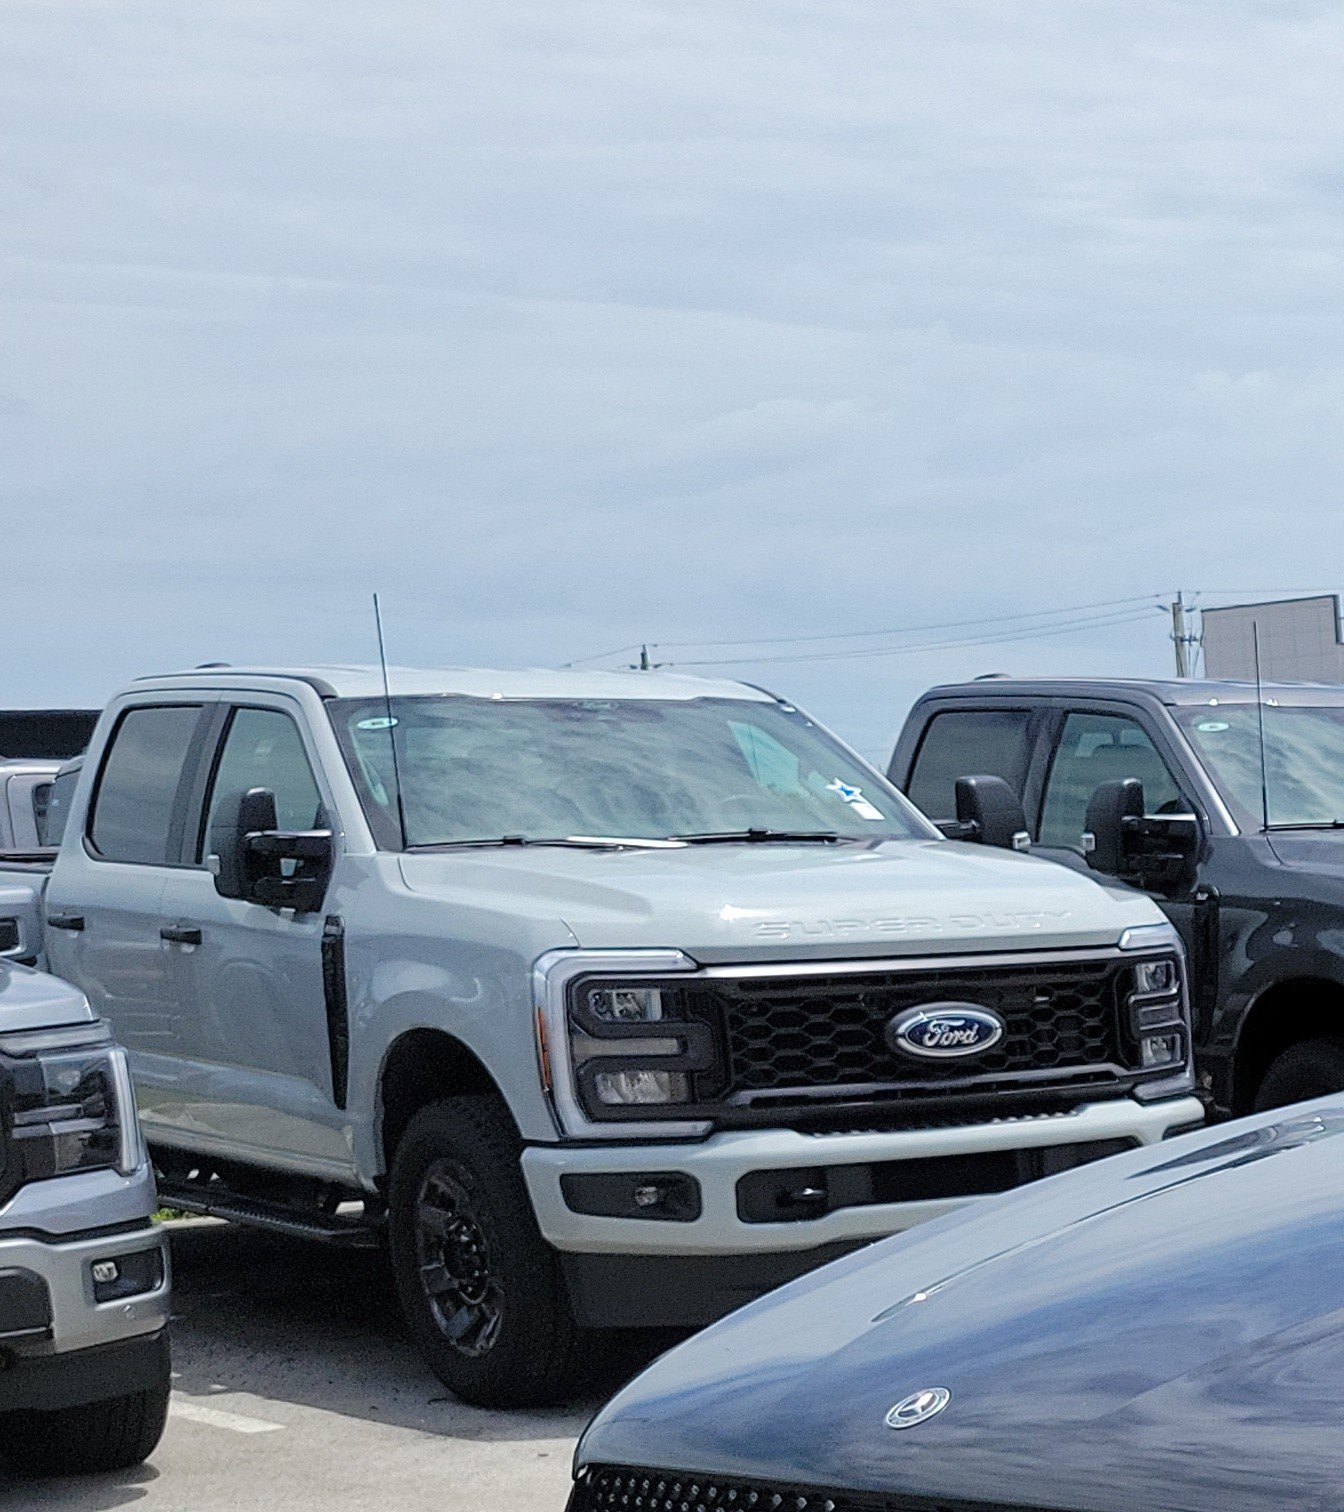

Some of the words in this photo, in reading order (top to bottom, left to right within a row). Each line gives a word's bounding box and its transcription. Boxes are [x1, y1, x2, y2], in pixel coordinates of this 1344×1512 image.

[755, 916, 942, 938] SUPER
[948, 911, 1070, 930] DUTY
[923, 1019, 979, 1047] Ford
